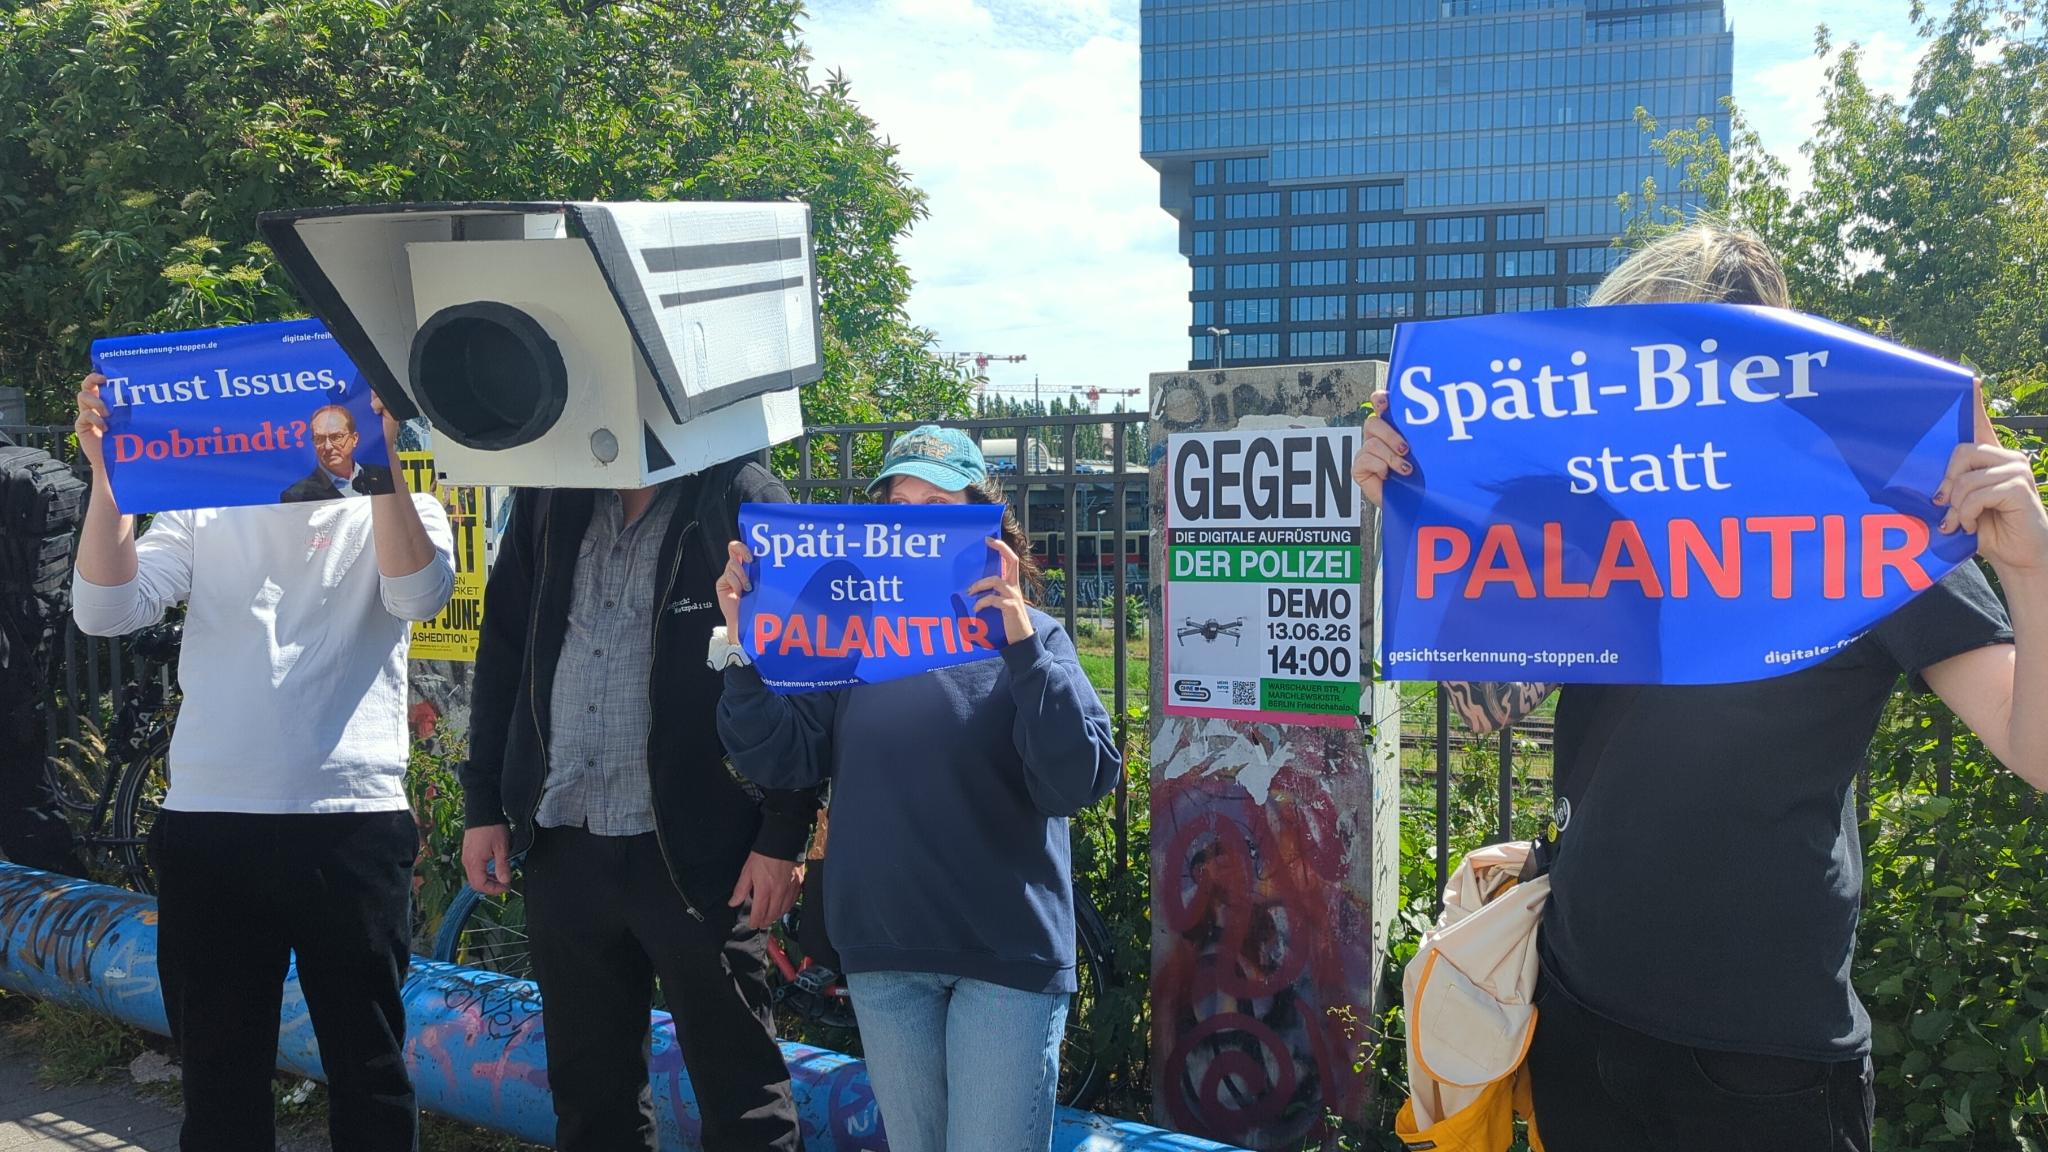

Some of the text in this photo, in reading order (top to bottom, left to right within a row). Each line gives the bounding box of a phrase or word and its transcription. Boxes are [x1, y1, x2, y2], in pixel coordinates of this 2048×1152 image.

[99, 341, 218, 360] gesichtserkennung-stoppen.de
[107, 367, 346, 408] Trust Issues,
[1399, 338, 1829, 441] Späti-Bier
[112, 420, 308, 464] Dobrindt?
[1174, 435, 1353, 522] GEGEN
[1567, 441, 1732, 495] statt
[751, 522, 947, 568] Späti-Bier
[1175, 528, 1352, 544] DIE DIGITALE AUFRÜSTUNG
[1175, 550, 1351, 579] DER POLIZEI
[1414, 513, 1934, 600] PALANTIR
[453, 586, 480, 596] RKET
[831, 574, 904, 602] statt
[1267, 588, 1352, 620] DEMO
[442, 598, 480, 631] JUNE
[411, 631, 468, 644] ASHEDITION
[753, 612, 996, 658] PALANTIR
[1266, 622, 1352, 642] 13.06.26
[1267, 645, 1352, 678] 14:00
[1388, 647, 1619, 668] gesichtserkennung-stoppen.de
[1268, 682, 1321, 693] WARSCHAUER
[1323, 685, 1340, 693] STR.
[1268, 700, 1295, 709] BERLIN
